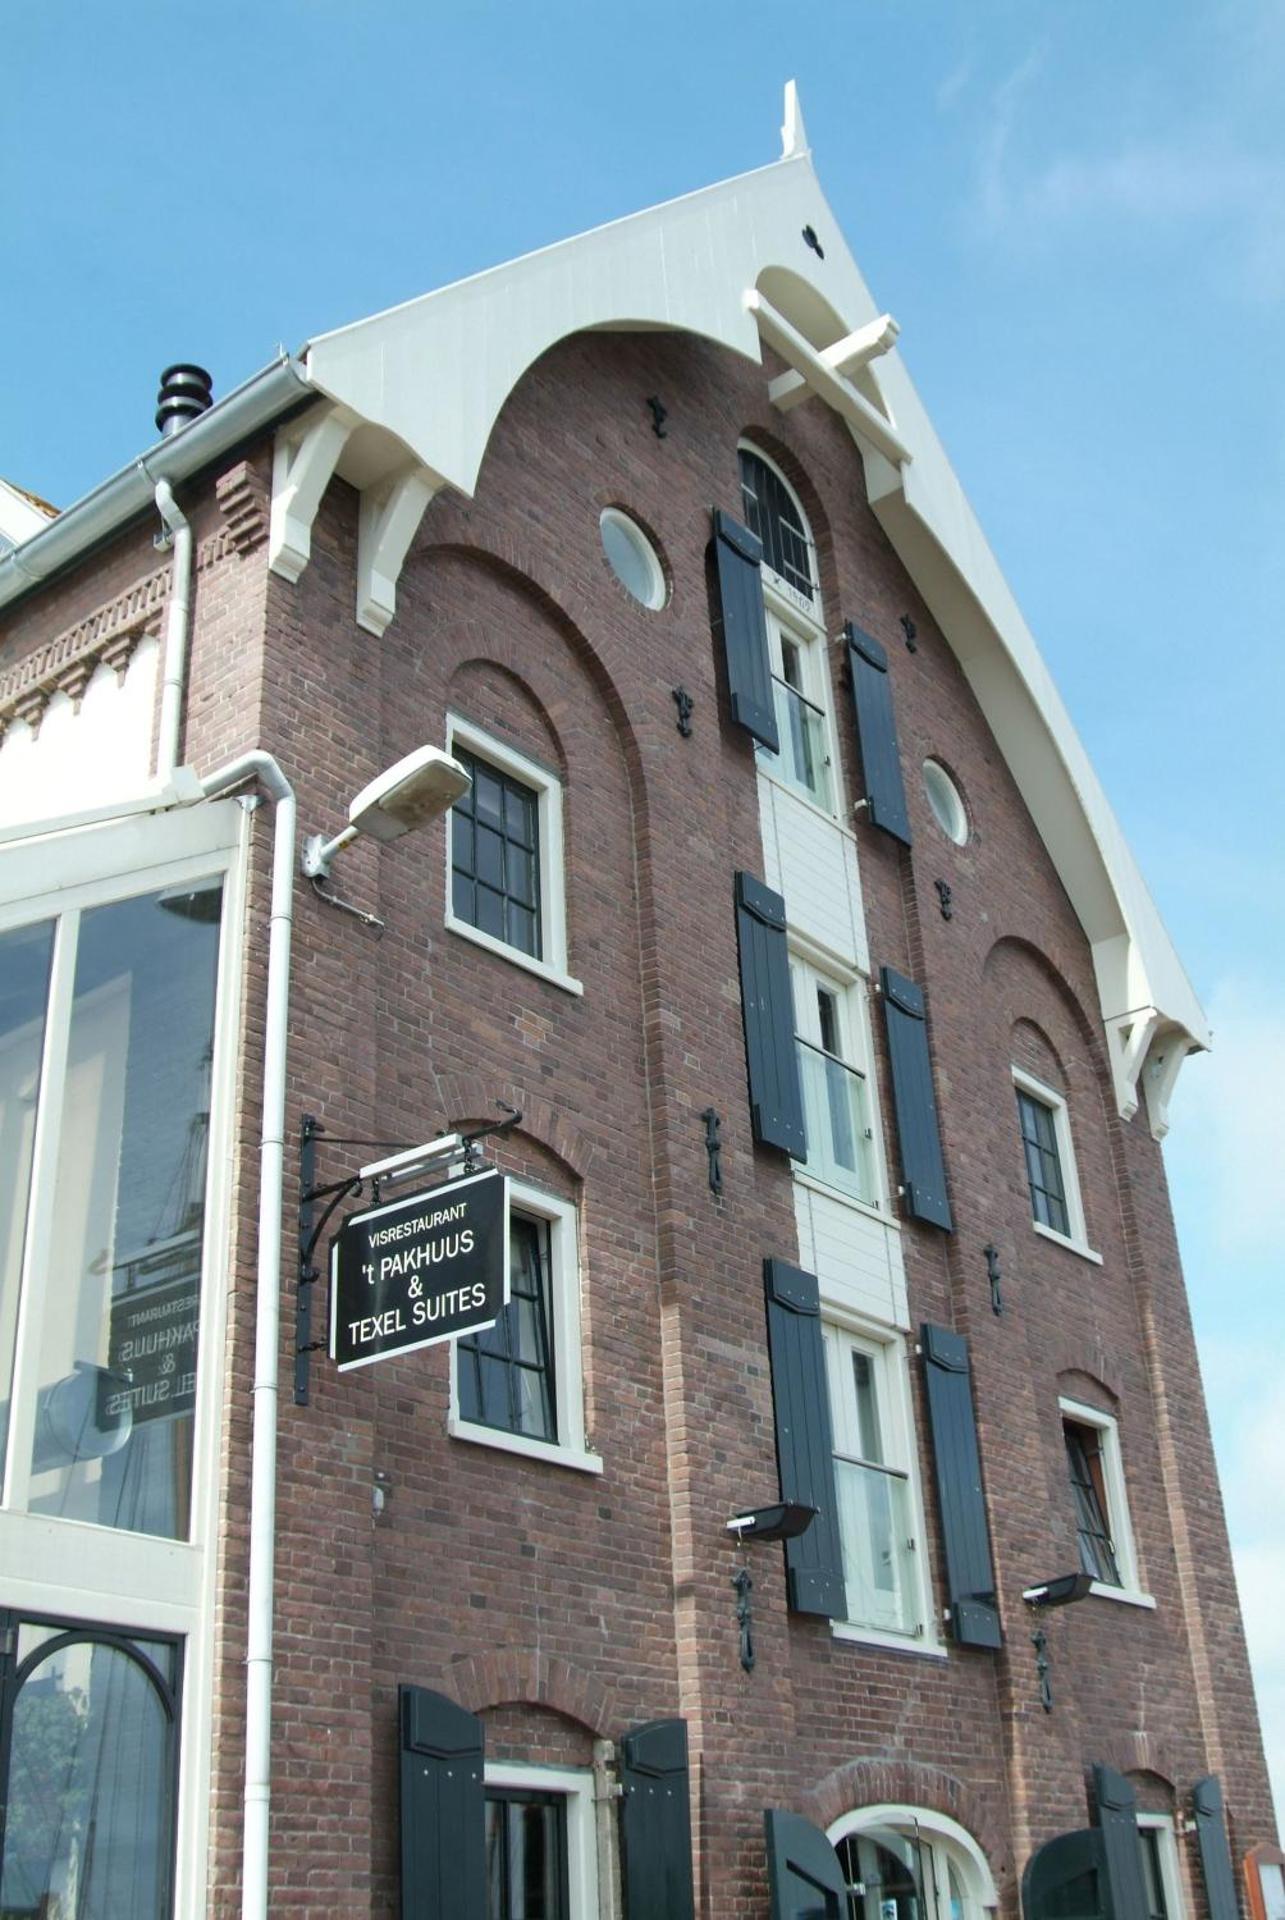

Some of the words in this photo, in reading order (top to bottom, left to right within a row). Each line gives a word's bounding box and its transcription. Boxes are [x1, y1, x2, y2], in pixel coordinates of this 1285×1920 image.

[368, 1203, 467, 1249] VISRESTAURANT
[362, 1264, 375, 1285] 't
[380, 1230, 475, 1281] PAKHUUS
[408, 1275, 423, 1299] &
[348, 1309, 407, 1345] TEXEL
[412, 1283, 486, 1326] SUITES
